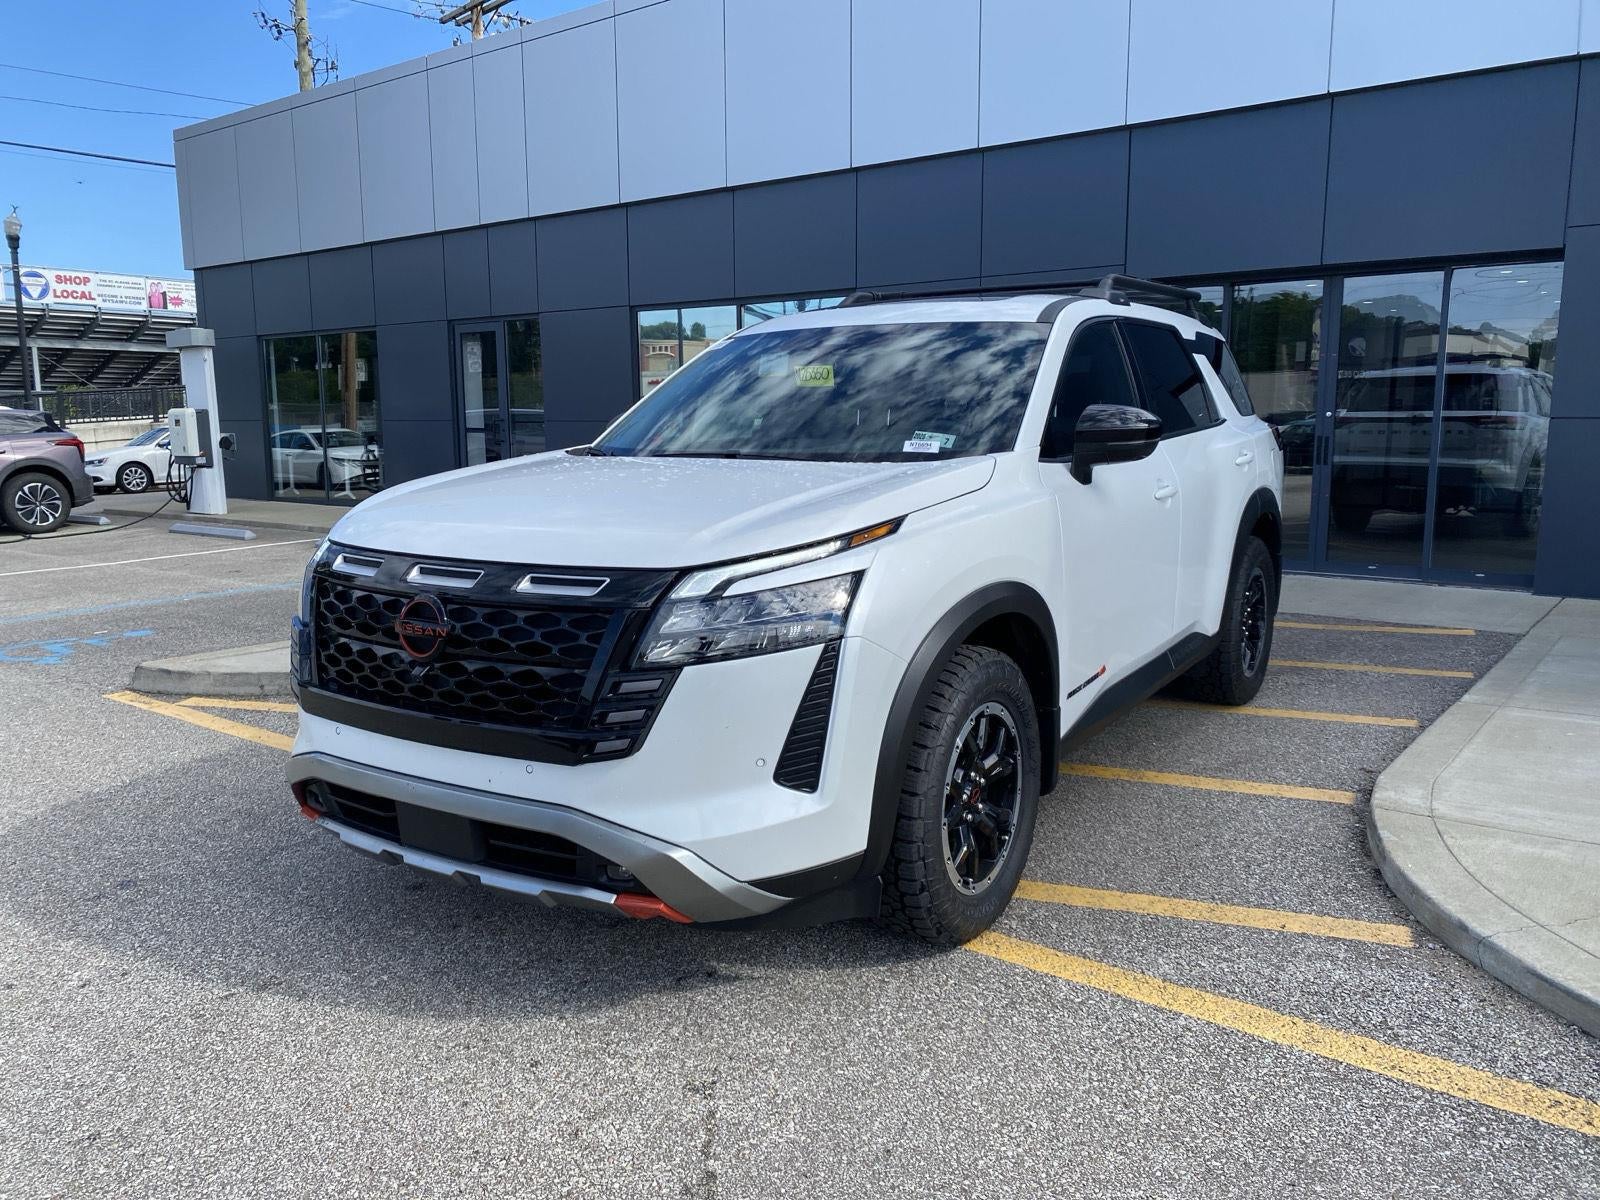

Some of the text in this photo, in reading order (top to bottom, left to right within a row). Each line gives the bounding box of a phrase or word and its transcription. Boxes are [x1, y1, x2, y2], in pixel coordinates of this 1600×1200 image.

[55, 274, 91, 286] SHOP
[53, 289, 96, 301] LOCAL
[395, 622, 447, 637] NISSAN
